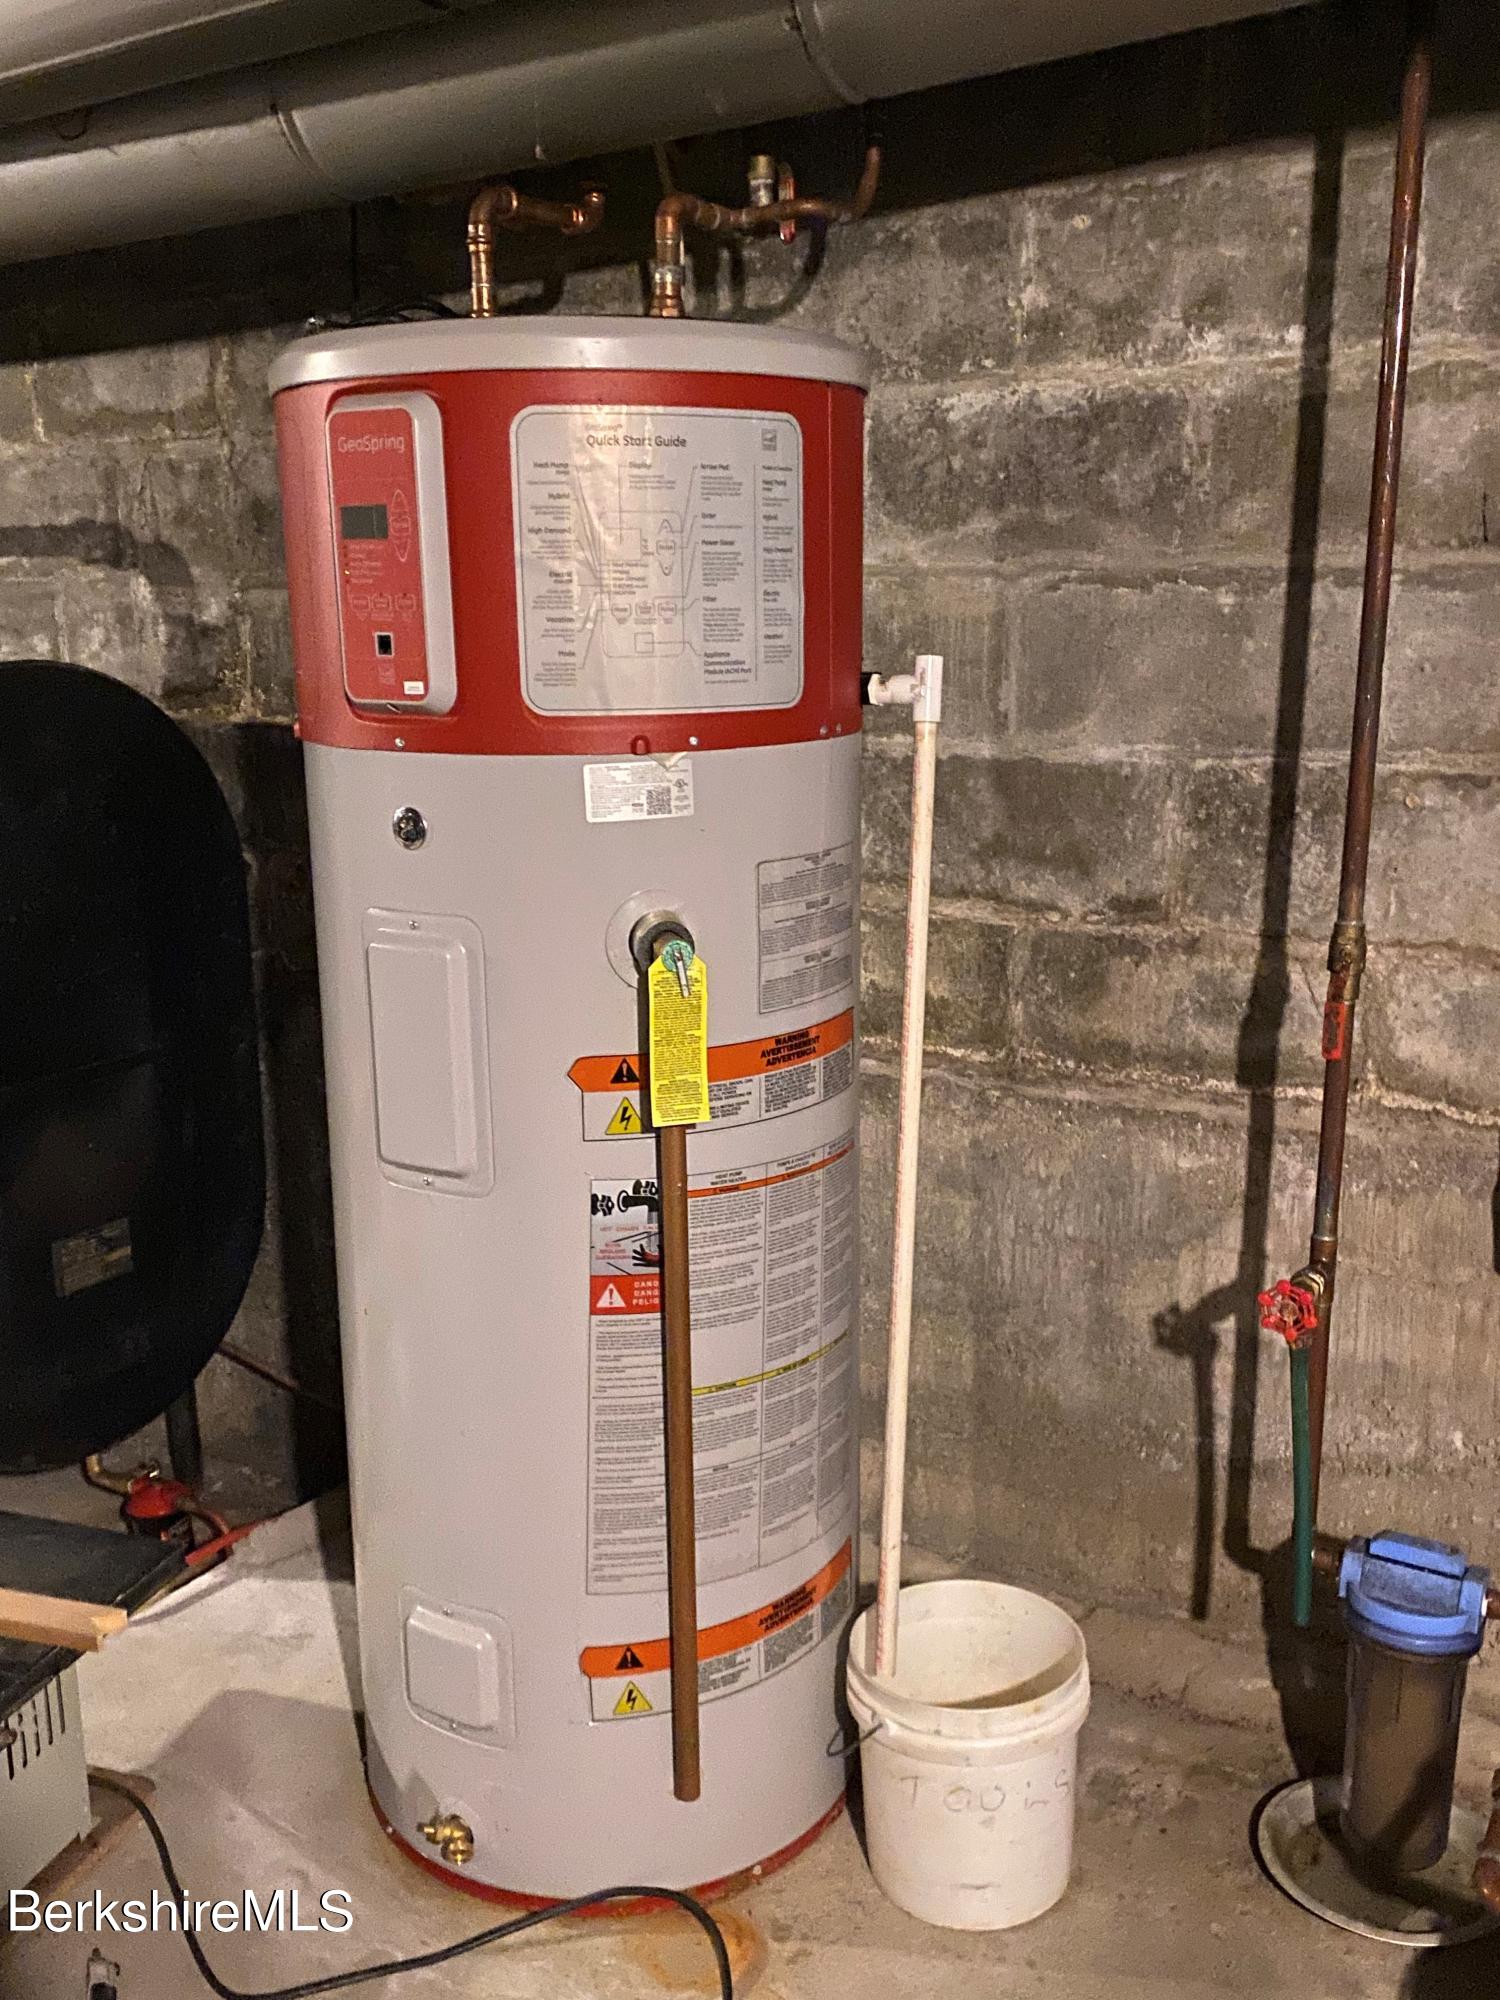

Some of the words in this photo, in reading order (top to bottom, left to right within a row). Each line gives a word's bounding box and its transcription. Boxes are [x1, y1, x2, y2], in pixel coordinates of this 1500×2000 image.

[337, 434, 405, 454] GeoSpring
[586, 434, 620, 448] Quick
[622, 435, 652, 447] Start
[654, 435, 687, 447] Guide
[774, 1030, 810, 1047] WARNING
[632, 1297, 660, 1305] PELIG
